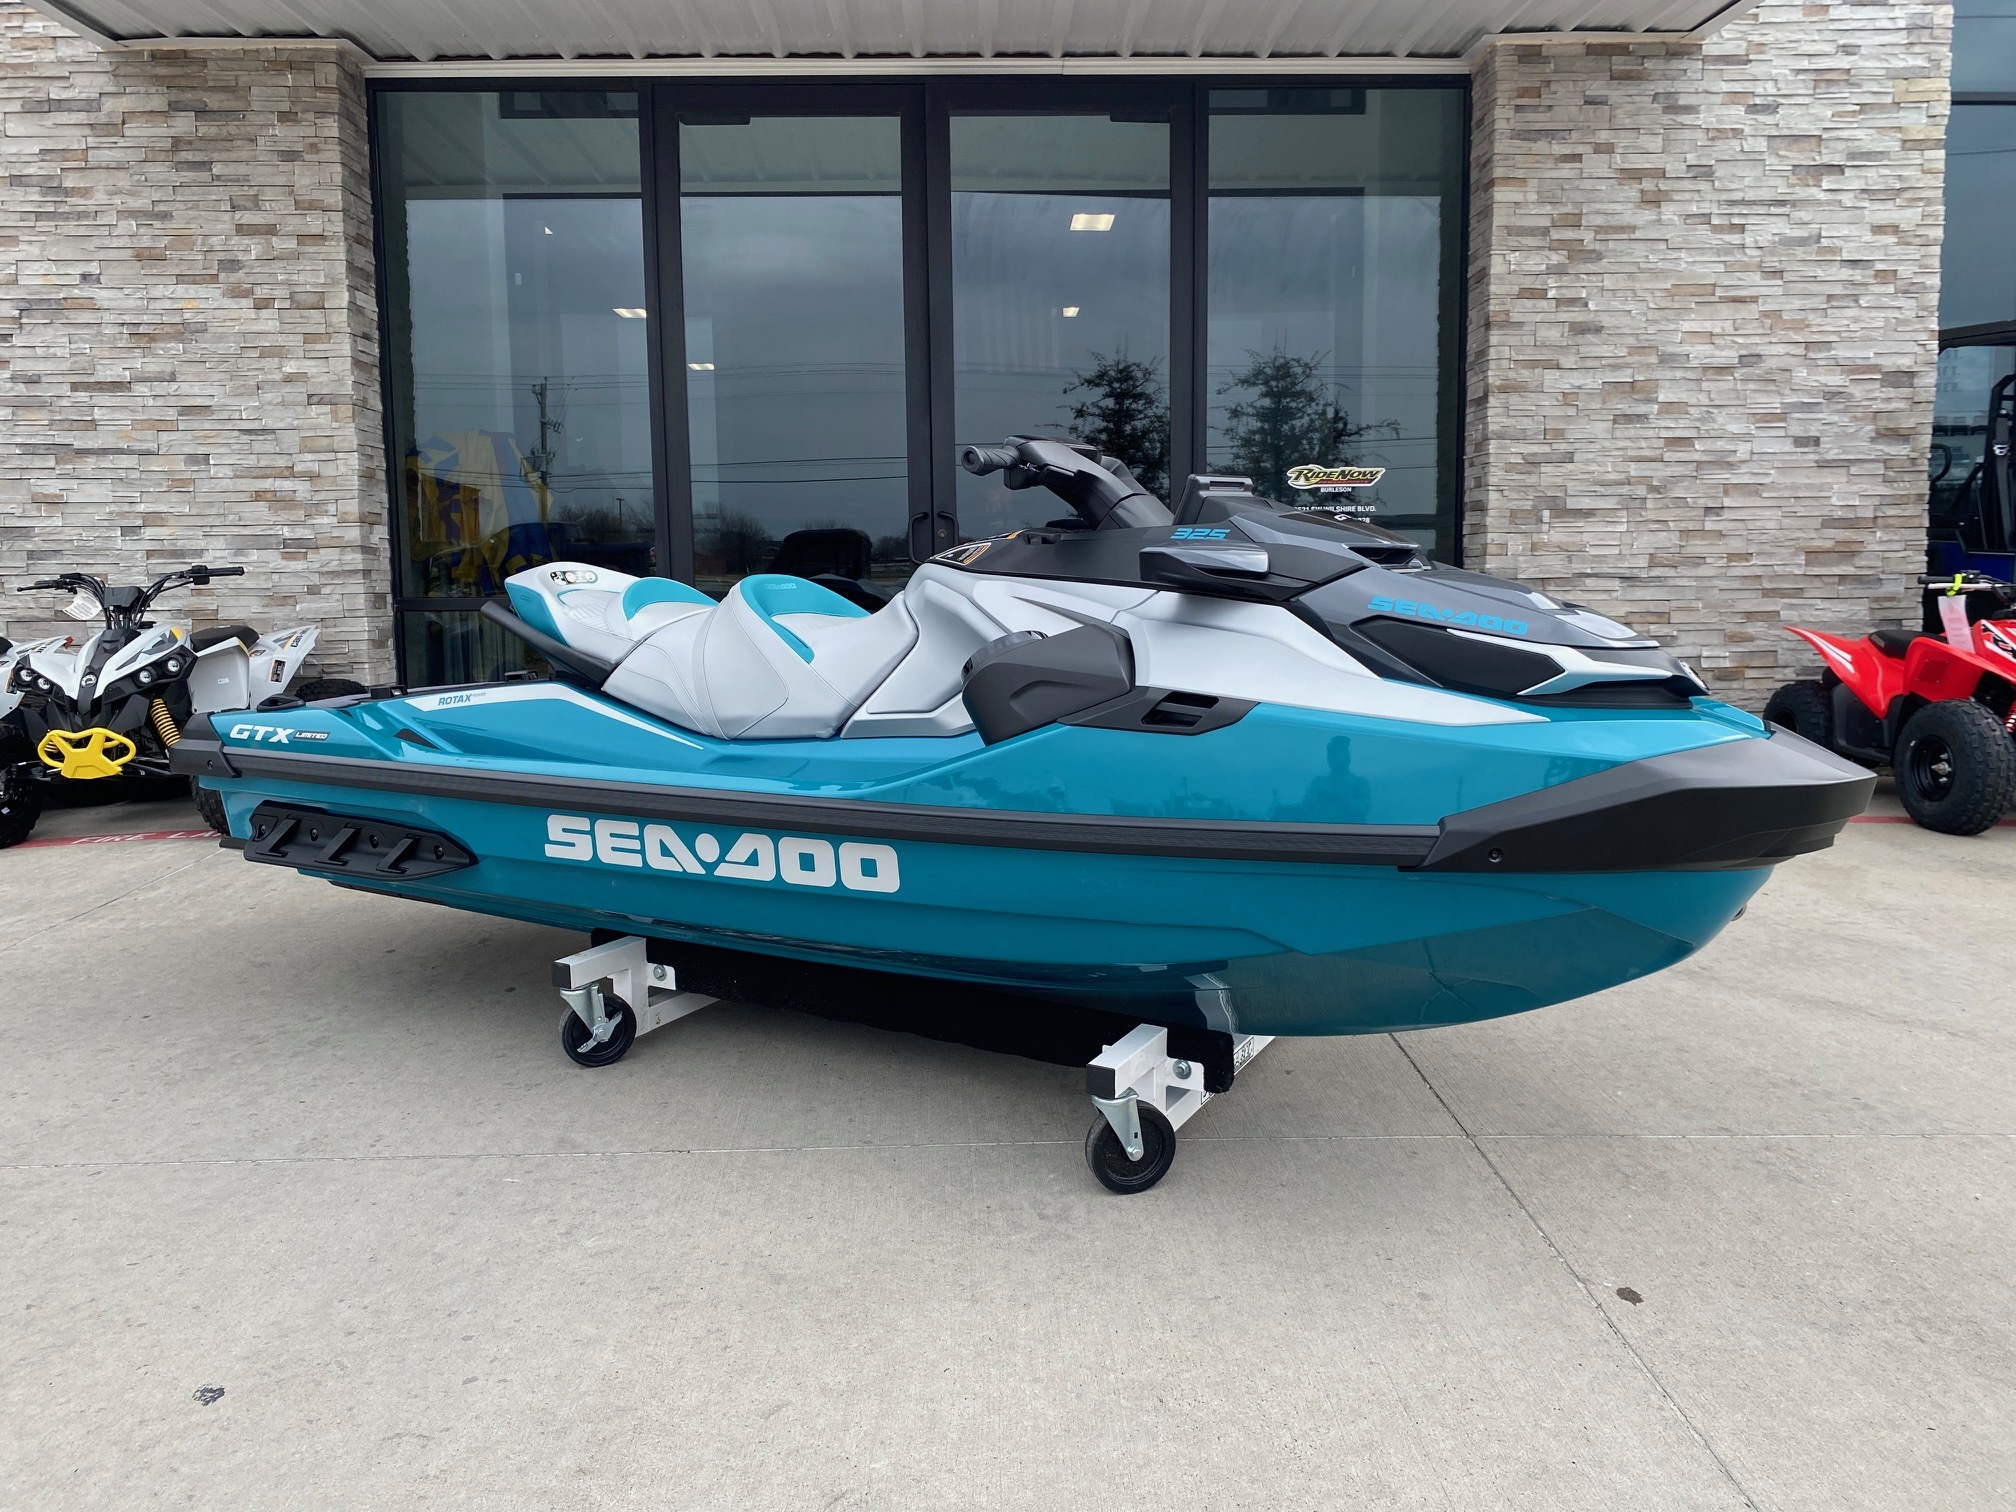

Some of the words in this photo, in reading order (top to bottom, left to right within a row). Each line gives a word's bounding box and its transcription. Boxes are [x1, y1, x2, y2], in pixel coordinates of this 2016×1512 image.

[1170, 528, 1231, 540] 325
[438, 694, 472, 706] ROTAX
[229, 723, 295, 744] GTX
[295, 731, 329, 739] LIMITED
